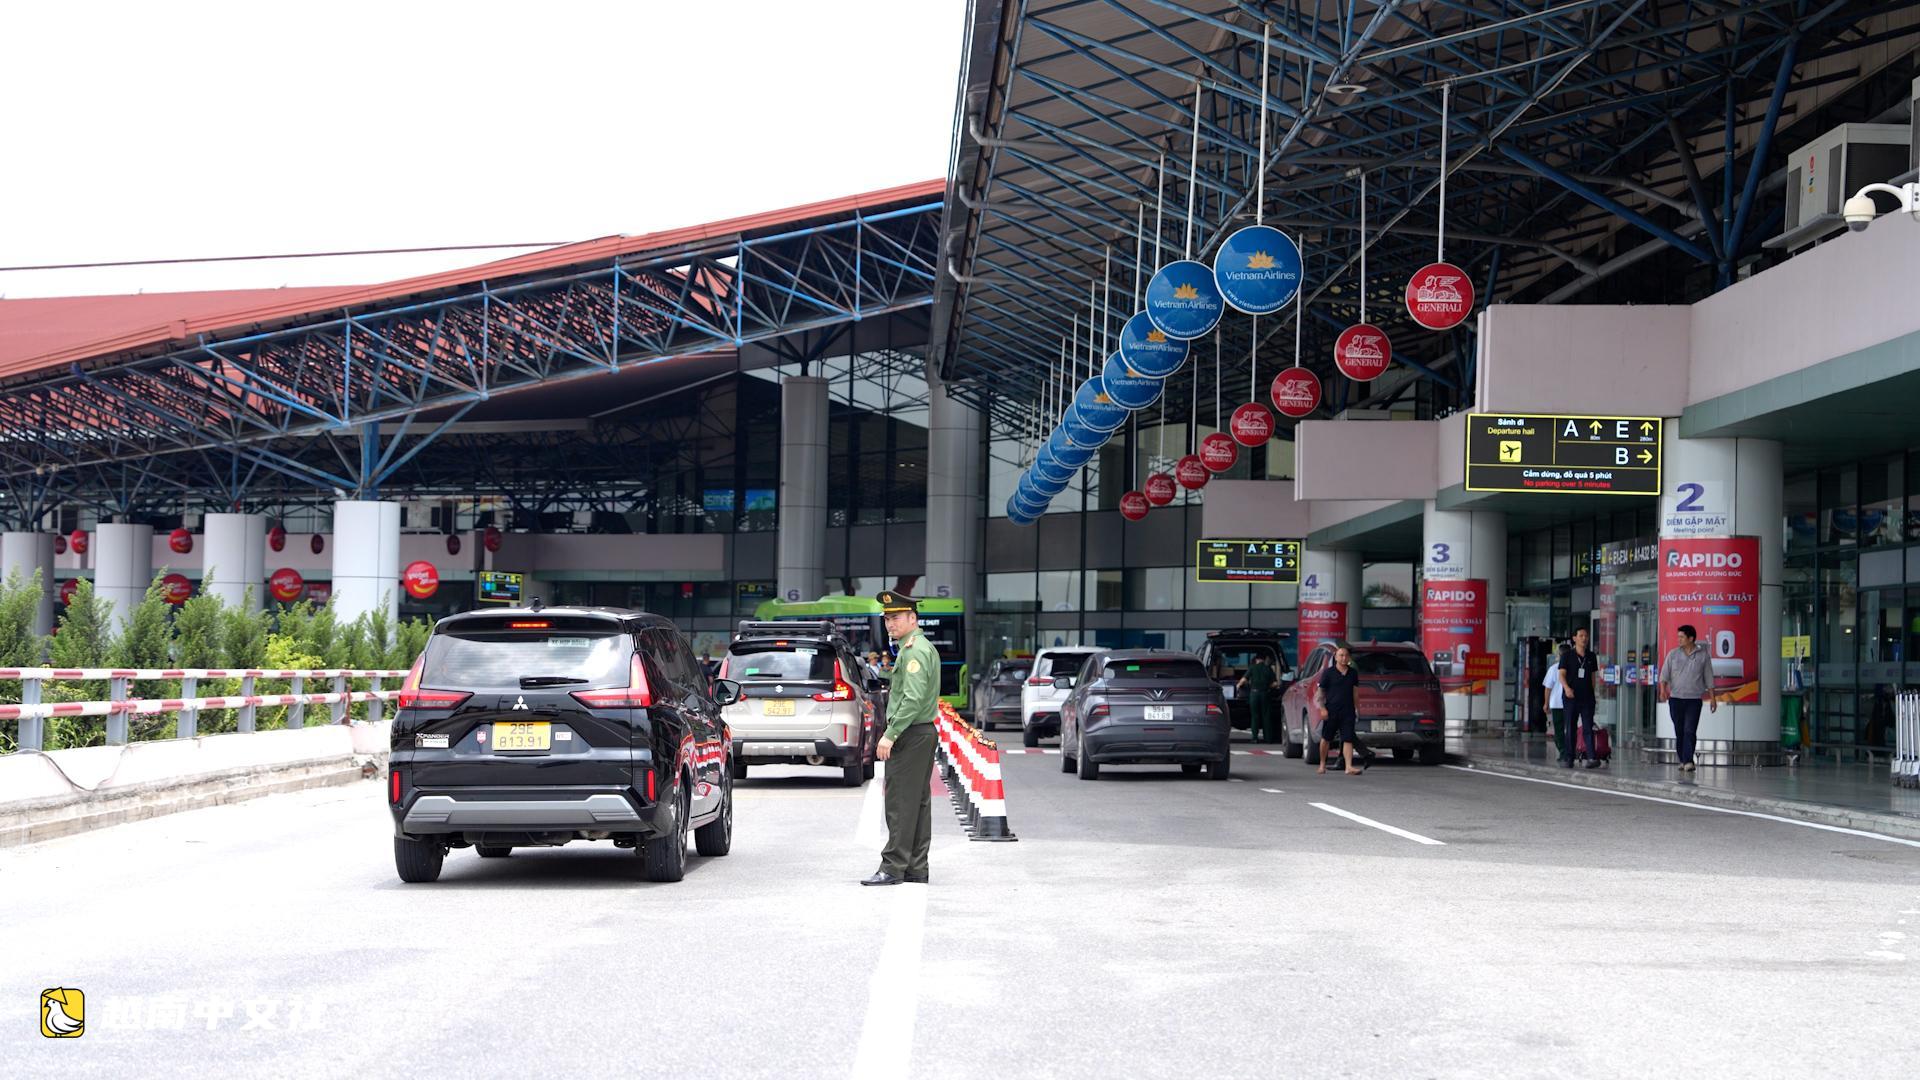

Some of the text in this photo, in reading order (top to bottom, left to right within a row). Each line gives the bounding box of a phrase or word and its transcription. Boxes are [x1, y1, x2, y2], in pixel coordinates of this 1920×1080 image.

[1417, 303, 1463, 313] GENERALI
[1345, 358, 1383, 368] GENERALI
[1279, 400, 1313, 408] GENERALI
[1237, 428, 1268, 437] GENERALI
[1487, 427, 1535, 436] Departure hall
[1563, 420, 1630, 439] A E
[1615, 448, 1629, 465] B
[1535, 480, 1560, 489] parking
[1584, 481, 1611, 489] minutes
[1676, 482, 1705, 512] 2
[1247, 543, 1283, 554] A E
[1431, 543, 1451, 564] 3
[1274, 557, 1283, 568] B
[1667, 550, 1742, 568] RAPIDO
[1305, 574, 1319, 589] 4
[787, 589, 800, 601] 6
[936, 585, 950, 598] 5
[1427, 588, 1476, 602] RAPIDO
[1706, 592, 1724, 601] GIÁ
[1302, 608, 1339, 619] RAPIDO
[510, 723, 534, 735] 29E
[499, 736, 542, 748] 813.91
